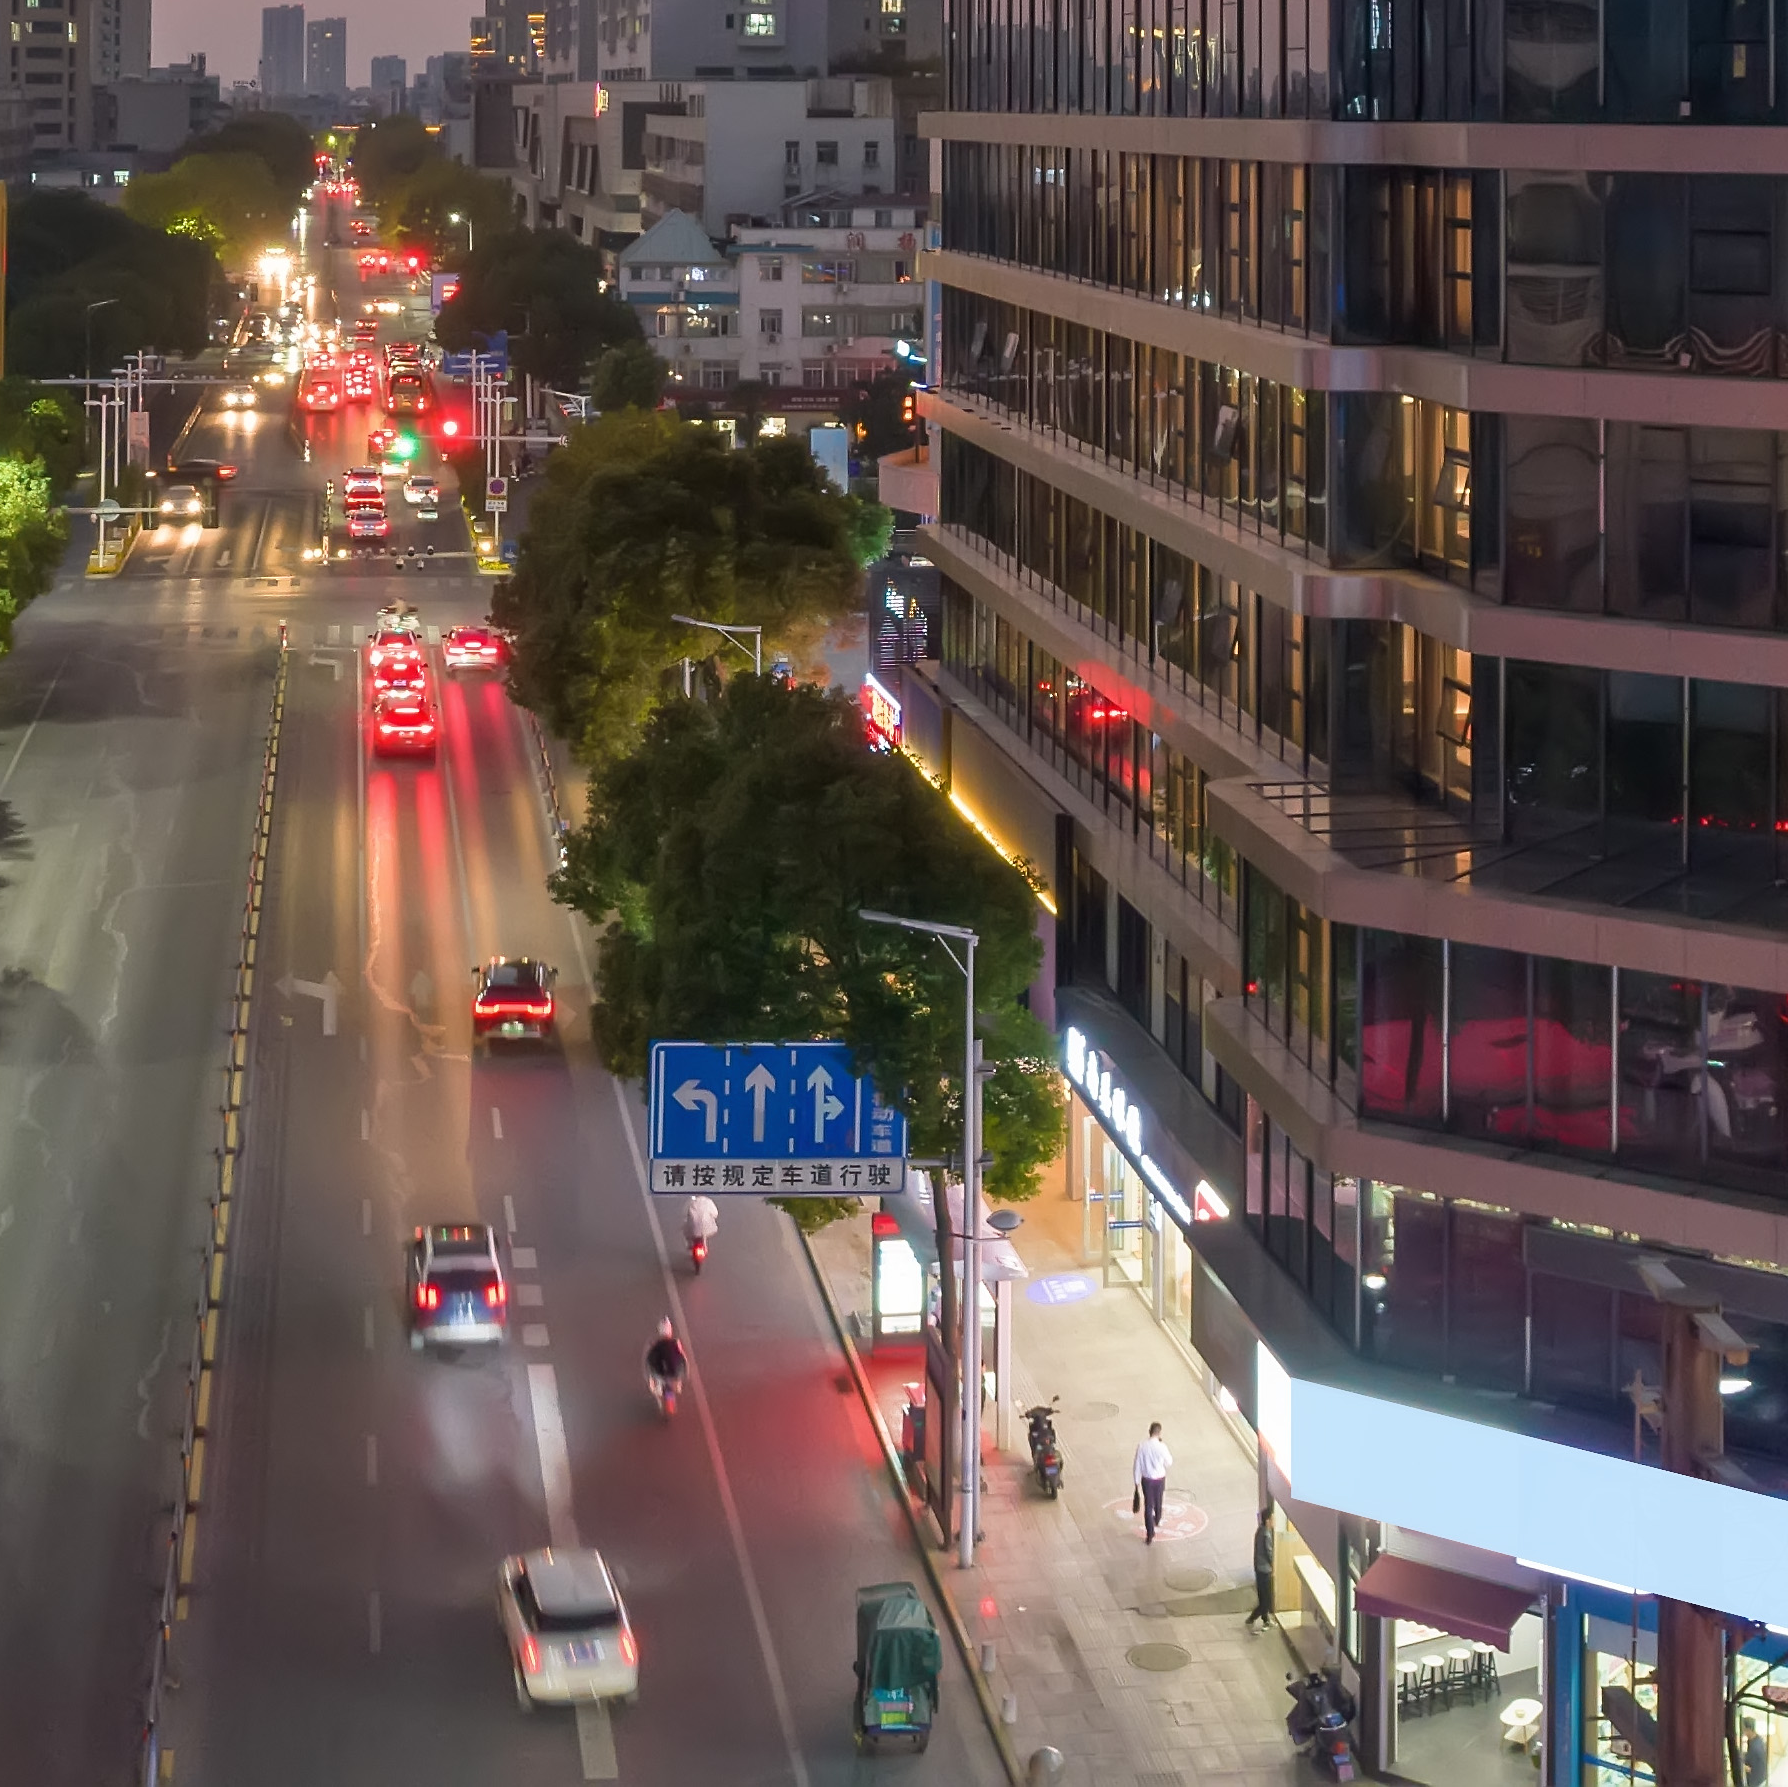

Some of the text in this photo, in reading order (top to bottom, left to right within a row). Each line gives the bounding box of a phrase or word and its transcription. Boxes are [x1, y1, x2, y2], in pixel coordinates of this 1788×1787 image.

[663, 1164, 891, 1187] 请按规定车道行驶
